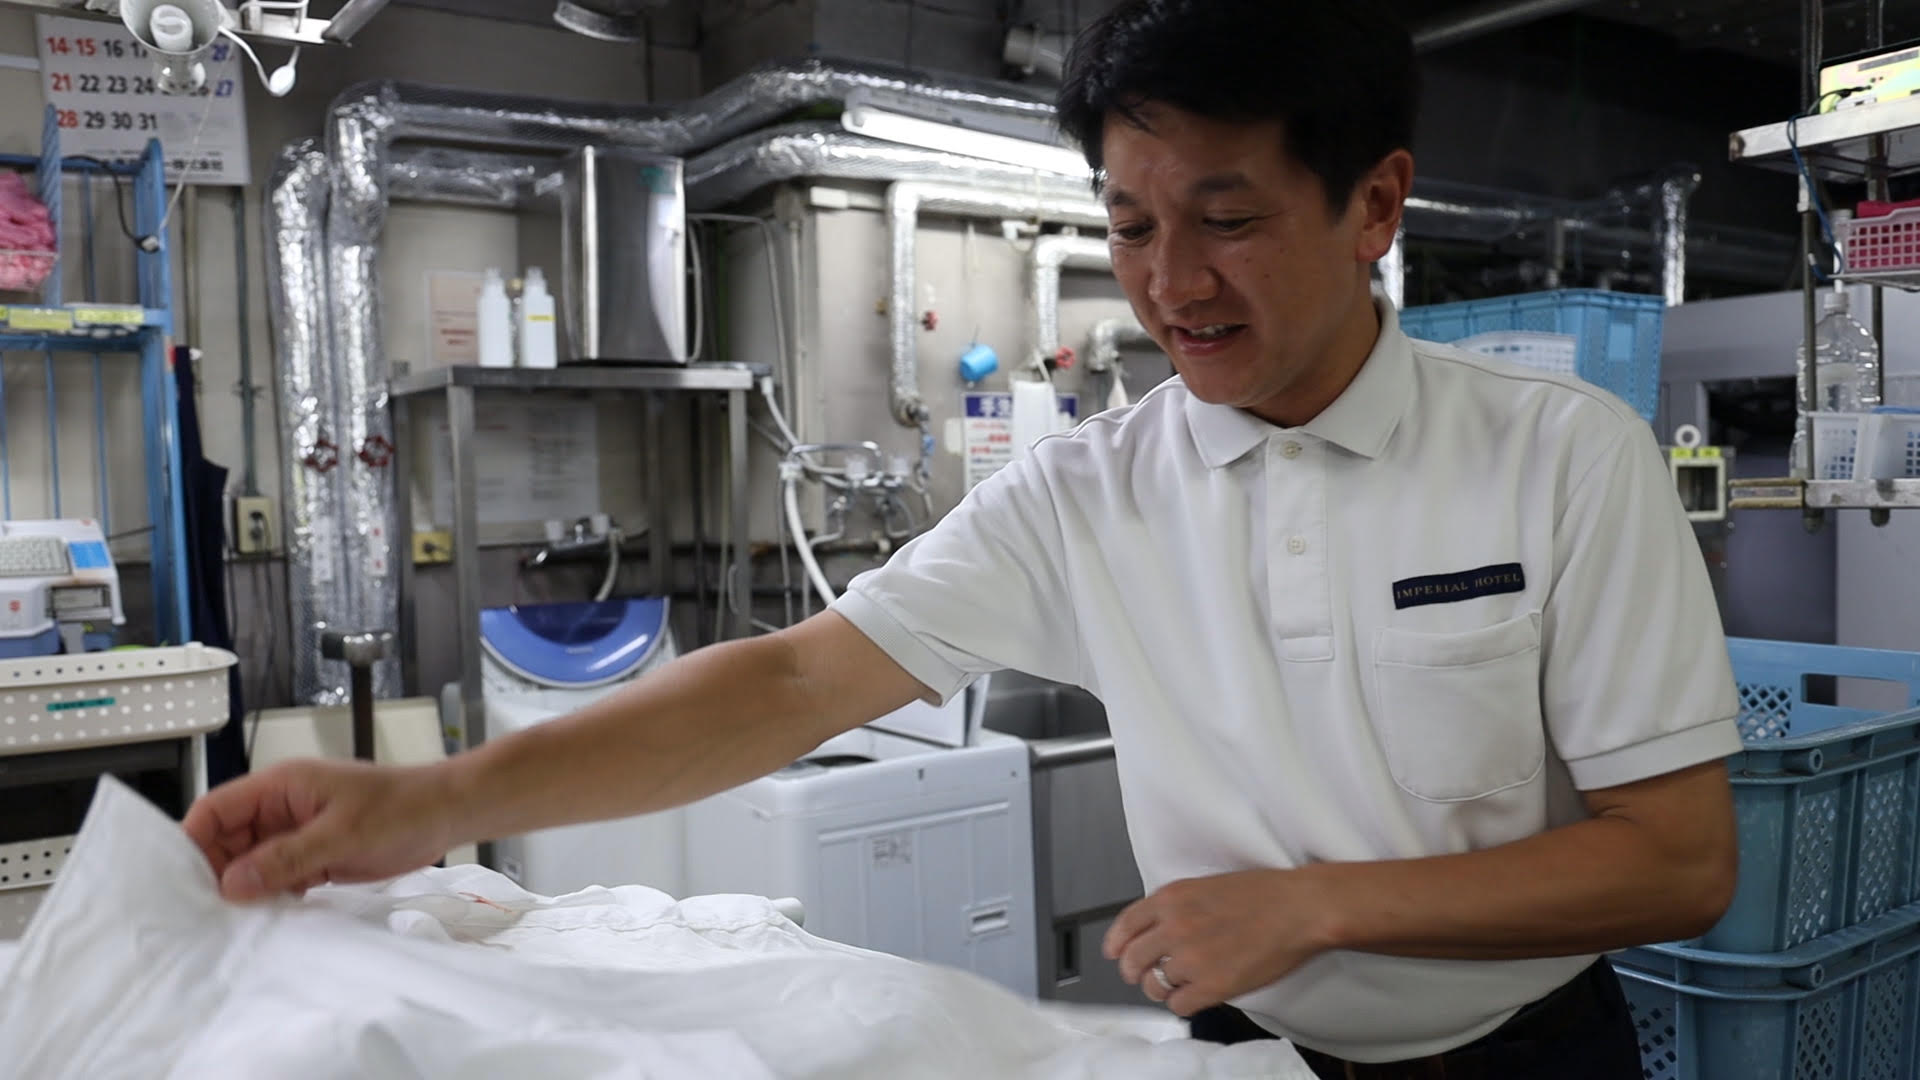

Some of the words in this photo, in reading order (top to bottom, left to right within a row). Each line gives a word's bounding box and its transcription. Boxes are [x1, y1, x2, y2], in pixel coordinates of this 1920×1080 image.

[48, 36, 71, 55] 14
[76, 37, 97, 56] 15
[104, 38, 124, 58] 16
[51, 72, 72, 92] 21
[79, 73, 100, 93] 22
[106, 74, 128, 94] 23
[133, 76, 155, 95] 24
[215, 79, 234, 96] 27
[57, 109, 78, 129] 28
[84, 111, 105, 130] 29
[112, 112, 132, 130] 30
[139, 112, 158, 130] 31
[1396, 581, 1469, 600] IMPERIAL
[1475, 573, 1520, 589] HOTEL
